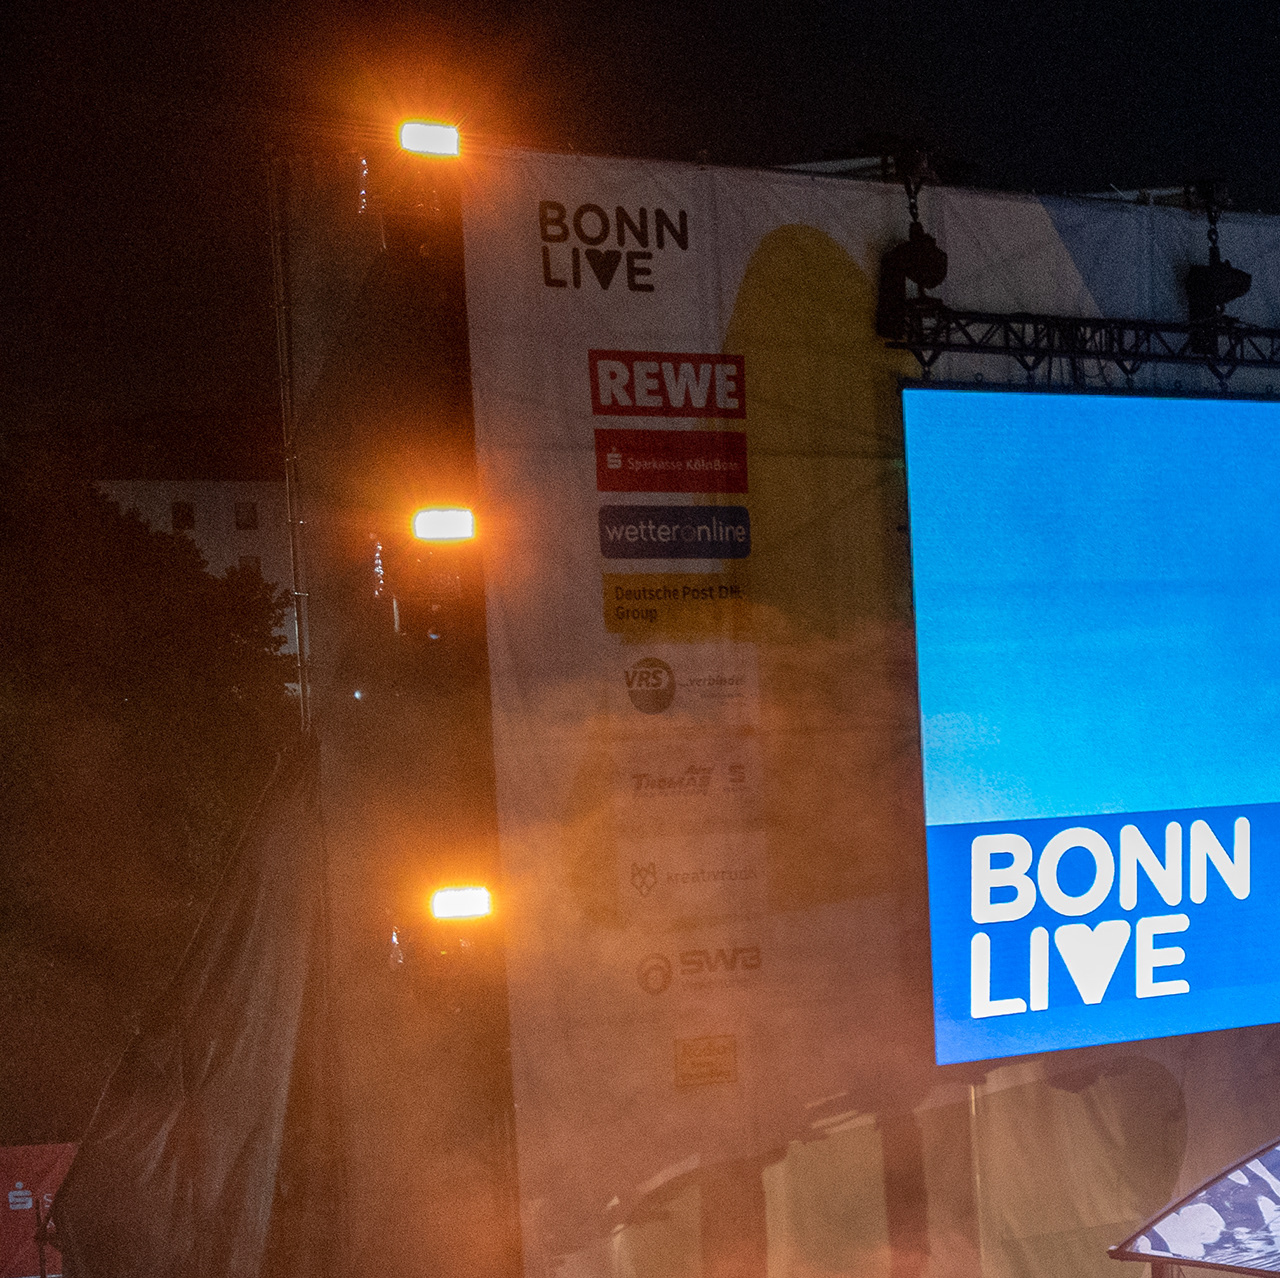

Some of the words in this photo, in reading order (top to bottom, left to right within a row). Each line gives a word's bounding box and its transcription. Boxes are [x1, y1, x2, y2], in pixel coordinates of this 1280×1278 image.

[538, 200, 690, 251] BONN
[540, 245, 656, 292] LIVE
[597, 360, 740, 409] REWE
[605, 516, 746, 543] wetteronline
[614, 585, 679, 601] Deutsche
[682, 585, 715, 601] Post
[614, 606, 658, 623] Group
[624, 670, 663, 689] VRS
[970, 816, 1252, 925] BONN
[679, 946, 763, 975] SWB
[970, 914, 1191, 1019] LIVE
